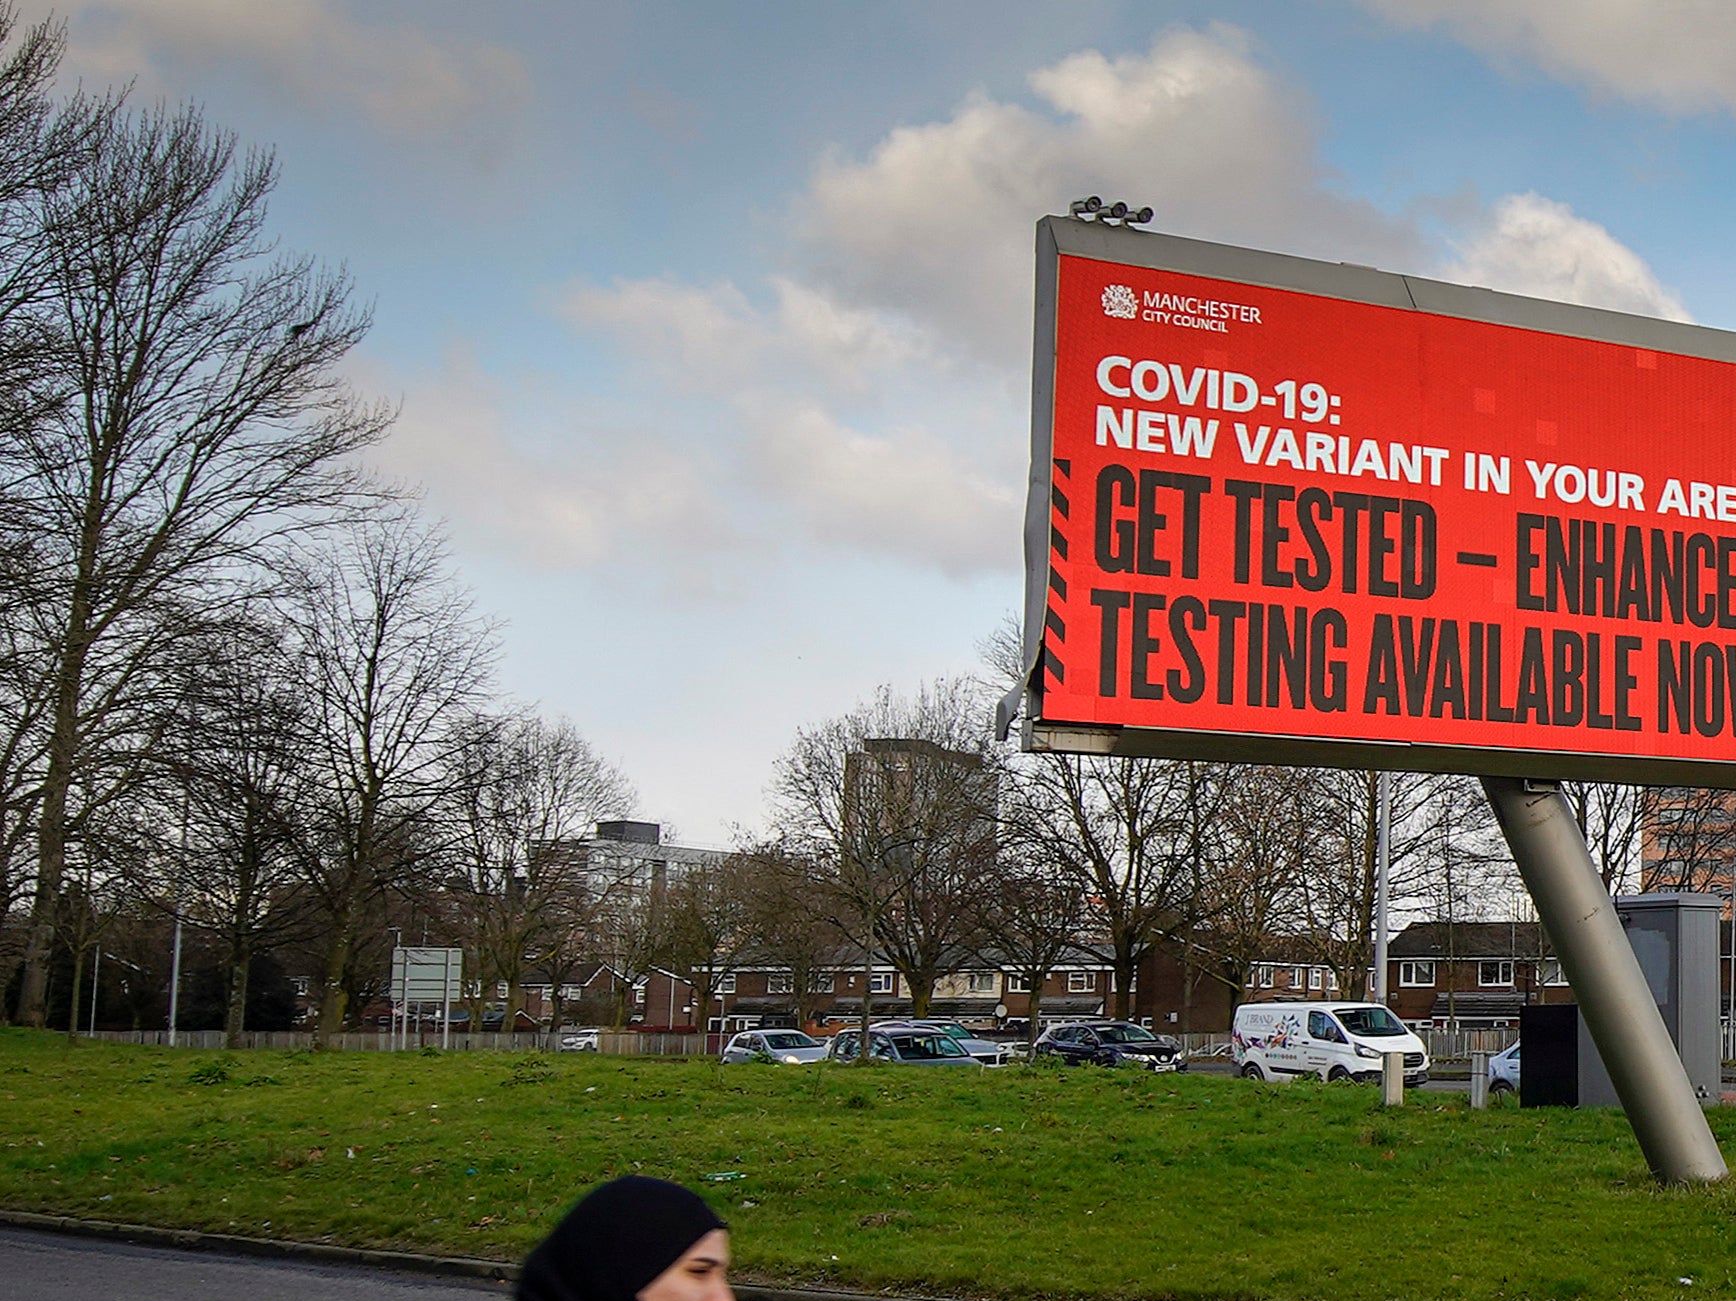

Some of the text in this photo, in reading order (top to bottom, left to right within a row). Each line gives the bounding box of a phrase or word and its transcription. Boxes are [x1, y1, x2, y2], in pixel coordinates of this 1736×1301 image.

[1142, 309, 1228, 333] CITY COUNCIL
[1143, 290, 1262, 324] MANCHESTER
[1096, 356, 1341, 424] COVID-19:
[1095, 405, 1219, 458] NEW
[1233, 422, 1449, 485] VARIANT
[1464, 452, 1510, 493] IN
[1525, 460, 1644, 511] YOUR
[1094, 464, 1210, 579] GET
[1226, 478, 1436, 600] TESTED
[1091, 590, 1347, 712] TESTING
[1363, 612, 1642, 732] AVAILABLE
